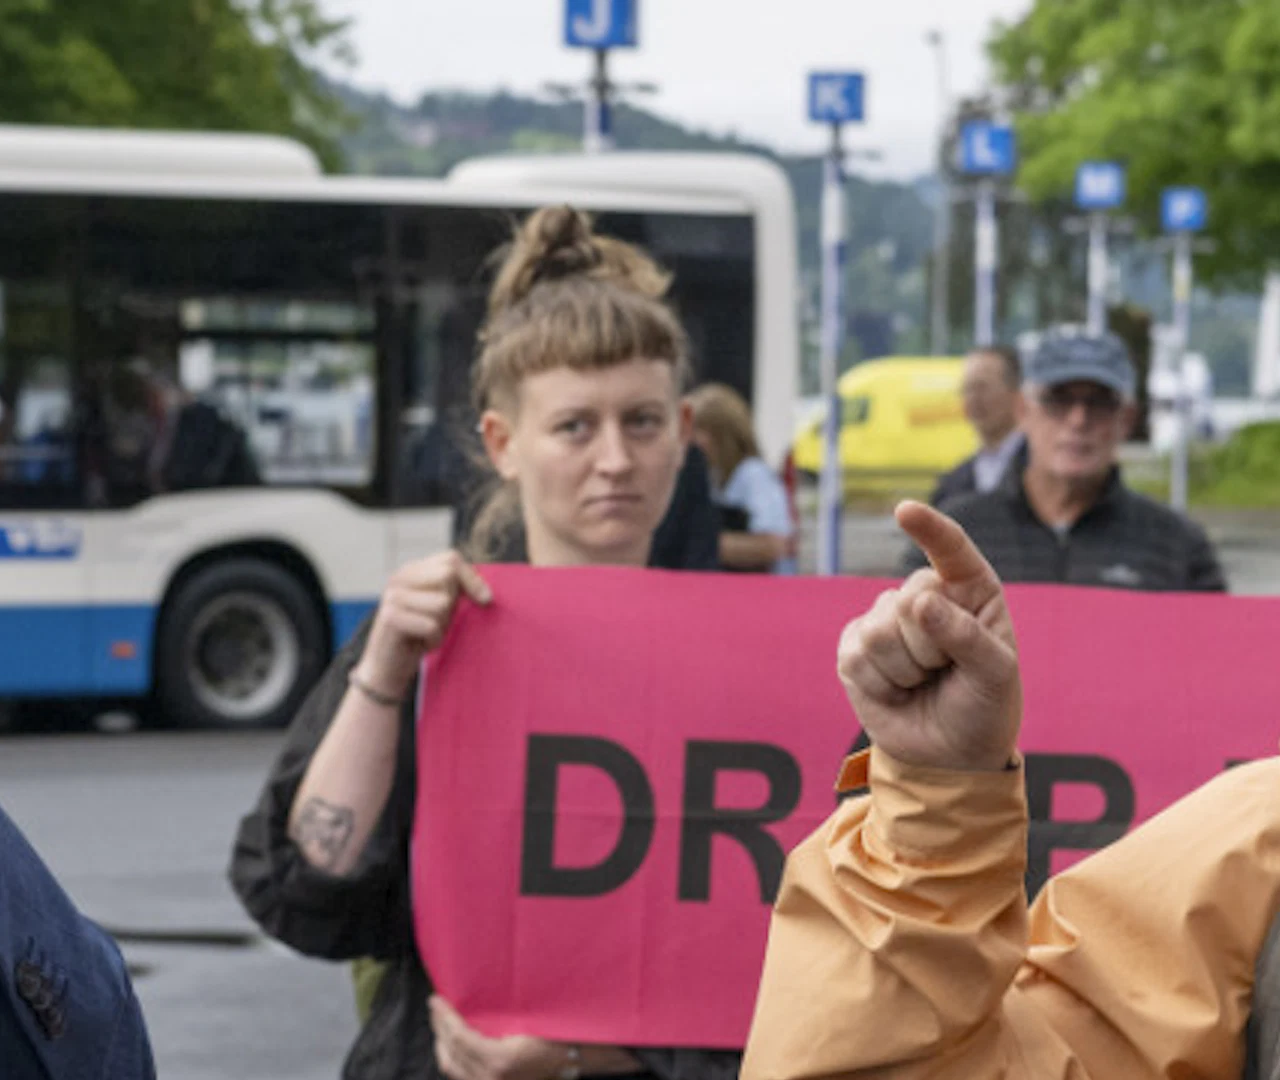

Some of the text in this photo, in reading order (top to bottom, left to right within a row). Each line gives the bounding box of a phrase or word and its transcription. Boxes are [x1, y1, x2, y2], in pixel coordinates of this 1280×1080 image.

[573, 0, 611, 43] J
[817, 81, 850, 117] K
[973, 126, 1001, 168] L
[519, 732, 1136, 905] DRP
